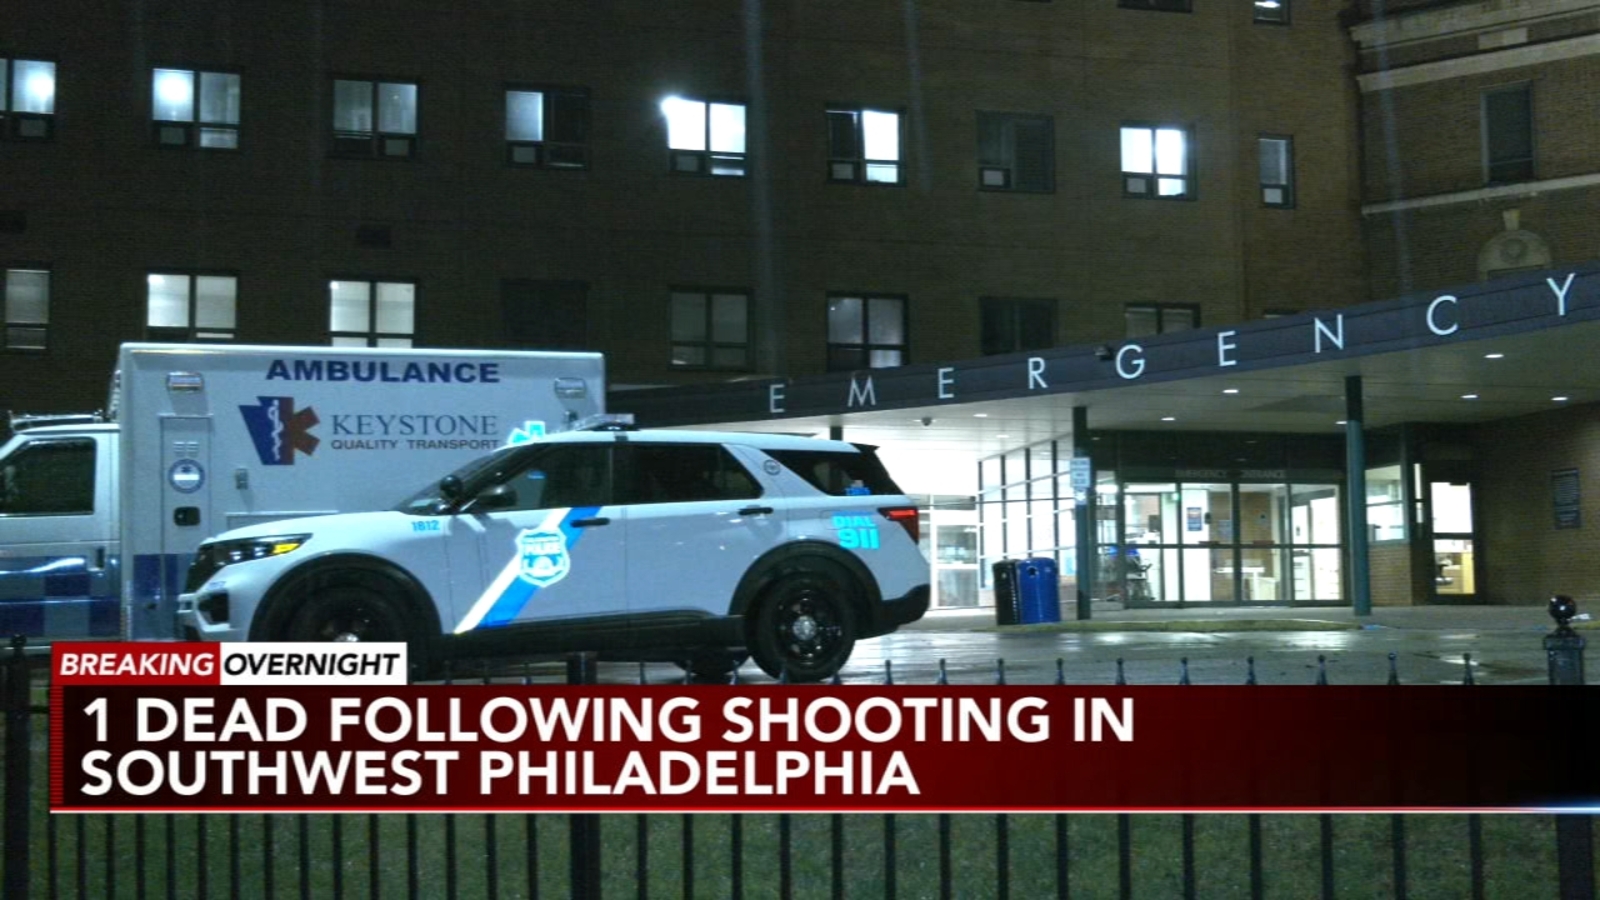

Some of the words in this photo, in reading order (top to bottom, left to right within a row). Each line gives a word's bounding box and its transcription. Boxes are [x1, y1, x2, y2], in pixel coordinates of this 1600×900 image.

[768, 271, 1577, 414] EMERGENCY
[266, 358, 500, 384] AMBULANCE
[331, 413, 499, 436] KEYSTONE
[331, 439, 398, 450] QUALITY
[407, 439, 500, 450] TRANSPORT
[831, 511, 878, 529] DIAL
[837, 528, 881, 550] 911
